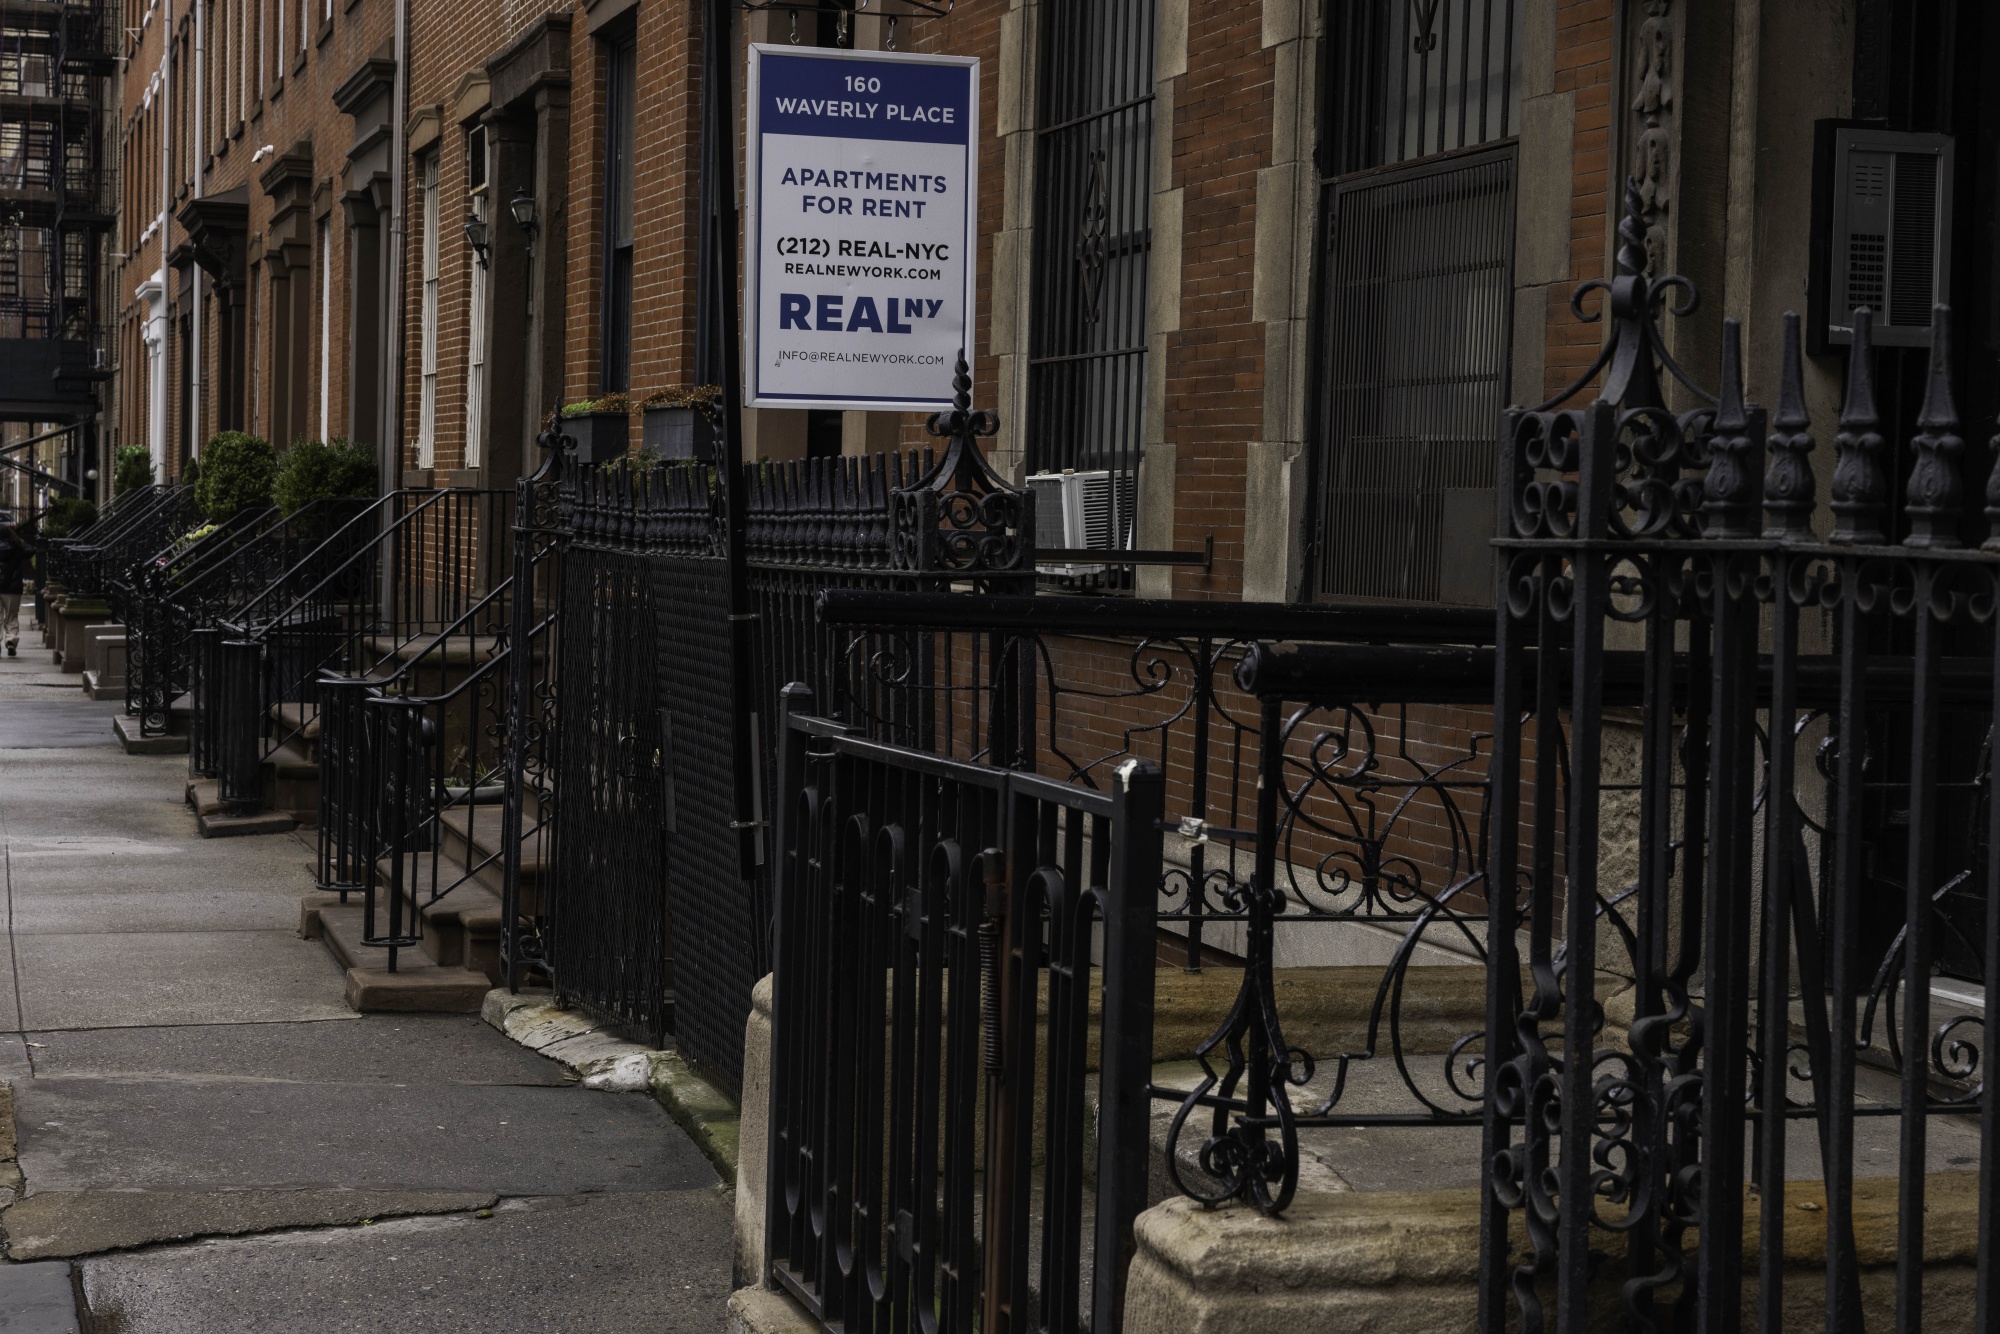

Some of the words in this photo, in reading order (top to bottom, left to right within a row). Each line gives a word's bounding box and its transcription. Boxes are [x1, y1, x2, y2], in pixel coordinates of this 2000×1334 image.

[845, 76, 880, 93] 160
[776, 97, 878, 119] WAVERLY
[887, 104, 954, 123] PLACE
[781, 168, 946, 193] APARTMENTS
[803, 196, 852, 215] FOR
[862, 198, 926, 218] RENT
[777, 237, 830, 257] (212)
[838, 240, 949, 260] REAL-NYC
[785, 263, 940, 280] REALNEWYORK.COM
[779, 351, 944, 365] INFO@REALNEWYORK.COM
